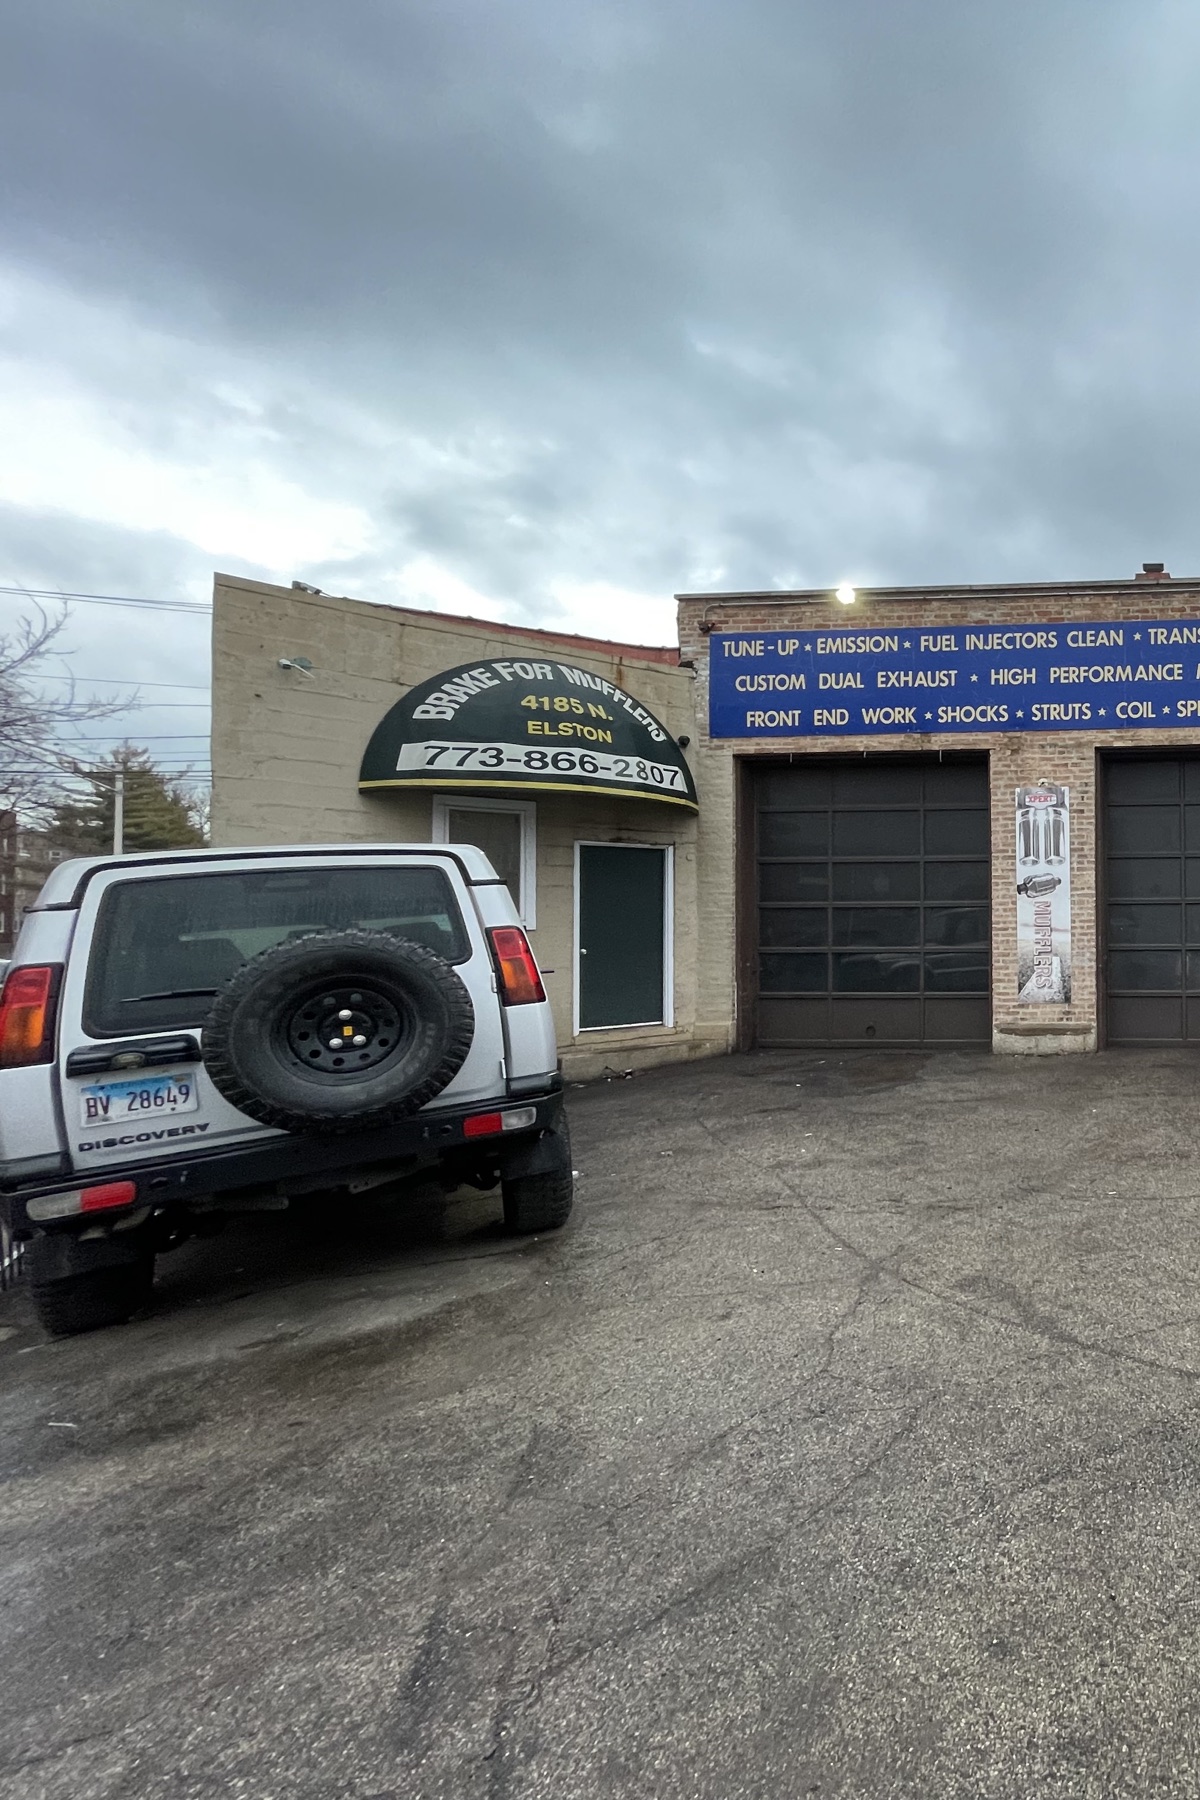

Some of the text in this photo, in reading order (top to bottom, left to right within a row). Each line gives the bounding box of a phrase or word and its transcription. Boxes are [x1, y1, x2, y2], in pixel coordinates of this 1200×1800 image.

[722, 639, 799, 657] TUNE-UP
[816, 636, 899, 654] EMISSION
[920, 634, 958, 652] FUEL
[965, 631, 1058, 650] INJECTORS
[1066, 630, 1124, 647] CLEAN
[735, 674, 806, 692] CUSTOM
[818, 672, 865, 690] DUAL
[877, 670, 958, 689] EXHAUST
[990, 668, 1036, 685] HIGH
[1050, 663, 1183, 684] PERFORMANCE
[412, 662, 667, 742] BRAKE FOR MUFFLERS
[521, 695, 614, 721] 4185 N.
[746, 710, 801, 728] FRONT
[813, 708, 849, 726] END
[861, 707, 917, 725] WORK
[937, 705, 1009, 723] SHOCKS
[1031, 703, 1091, 721] STRUTS
[1115, 701, 1156, 719] COIL
[527, 720, 613, 744] ELSTON
[423, 745, 680, 787] 773-866-2807
[1033, 901, 1053, 989] MUFFLERS
[86, 1084, 190, 1118] BV 28649
[78, 1123, 210, 1152] DISCOVERY
